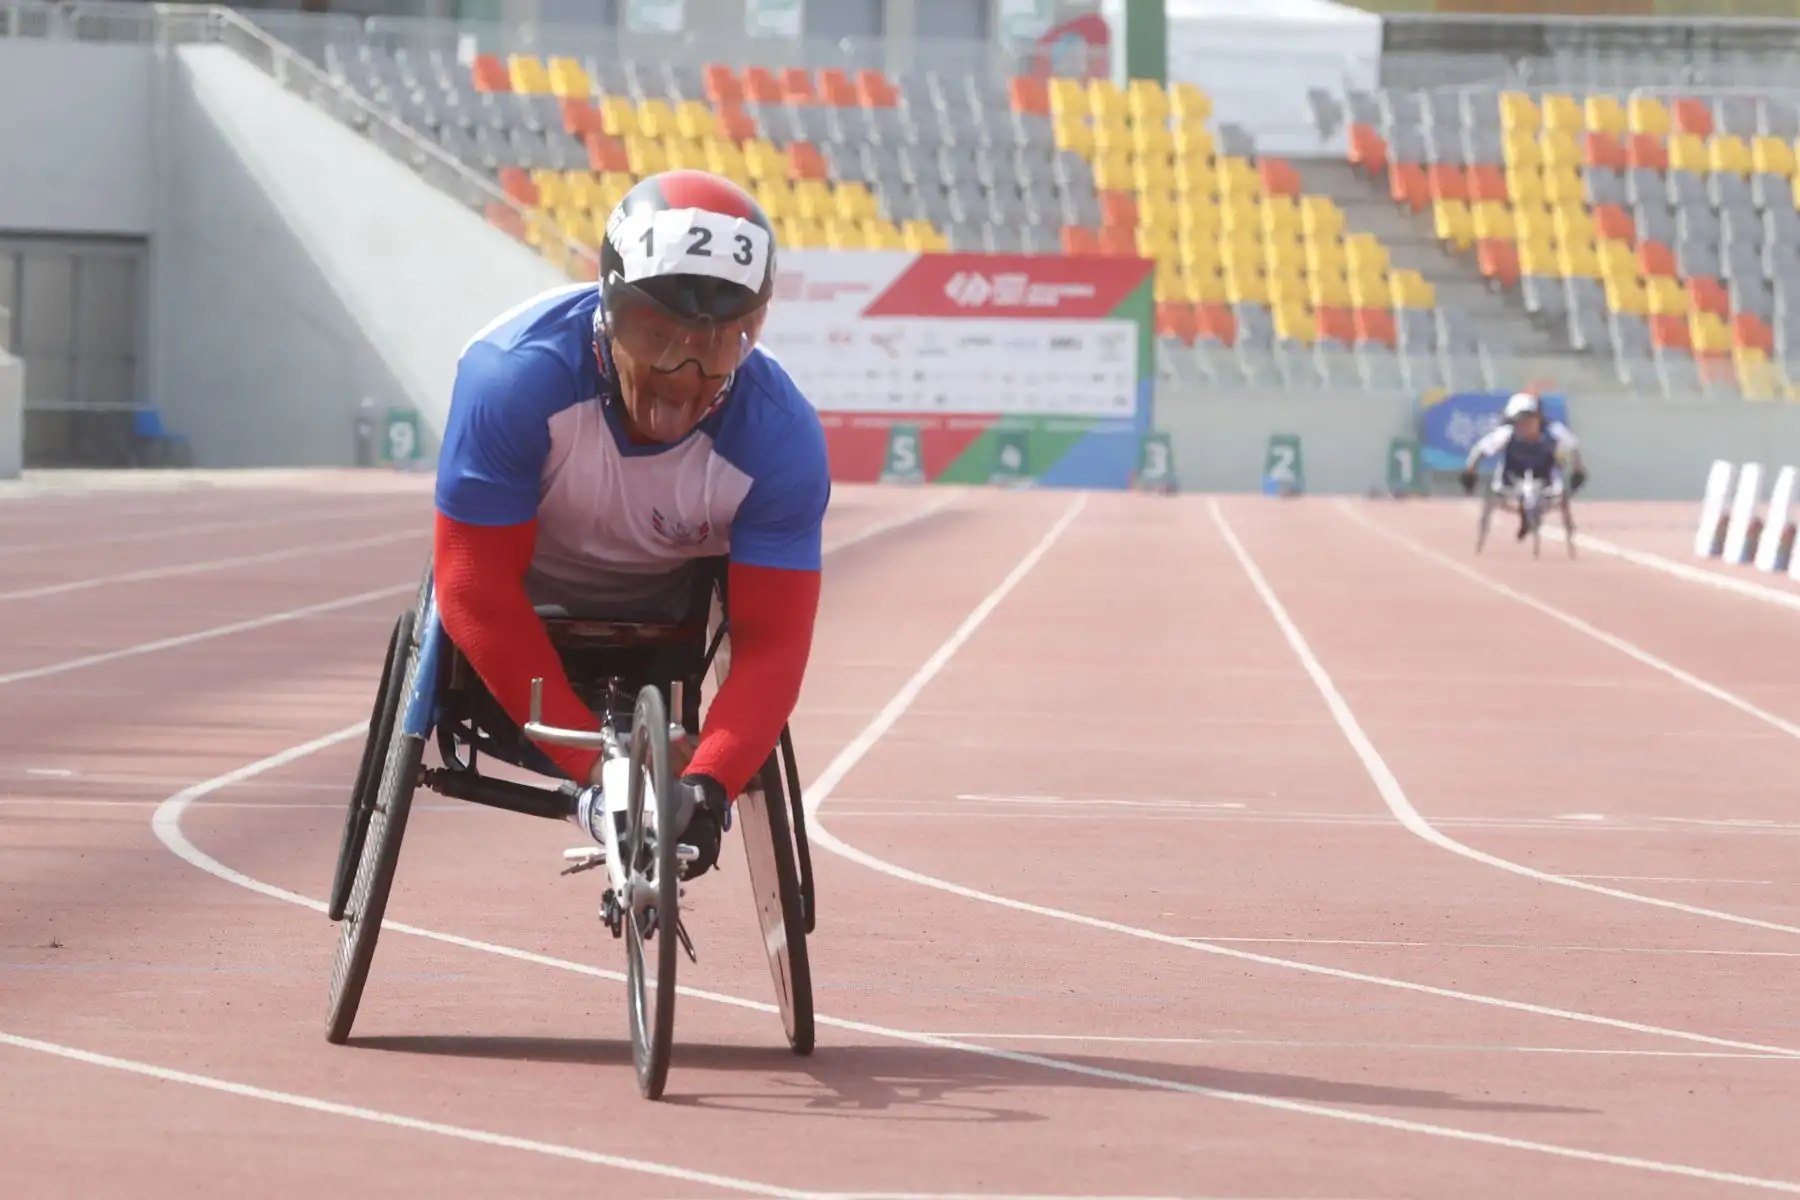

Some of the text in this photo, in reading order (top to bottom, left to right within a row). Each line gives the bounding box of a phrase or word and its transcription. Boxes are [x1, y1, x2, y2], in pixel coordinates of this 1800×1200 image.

[638, 226, 753, 267] 123
[388, 420, 414, 459] 9
[892, 435, 917, 472] 5
[1268, 444, 1297, 482] 2
[1393, 446, 1413, 484] 1
